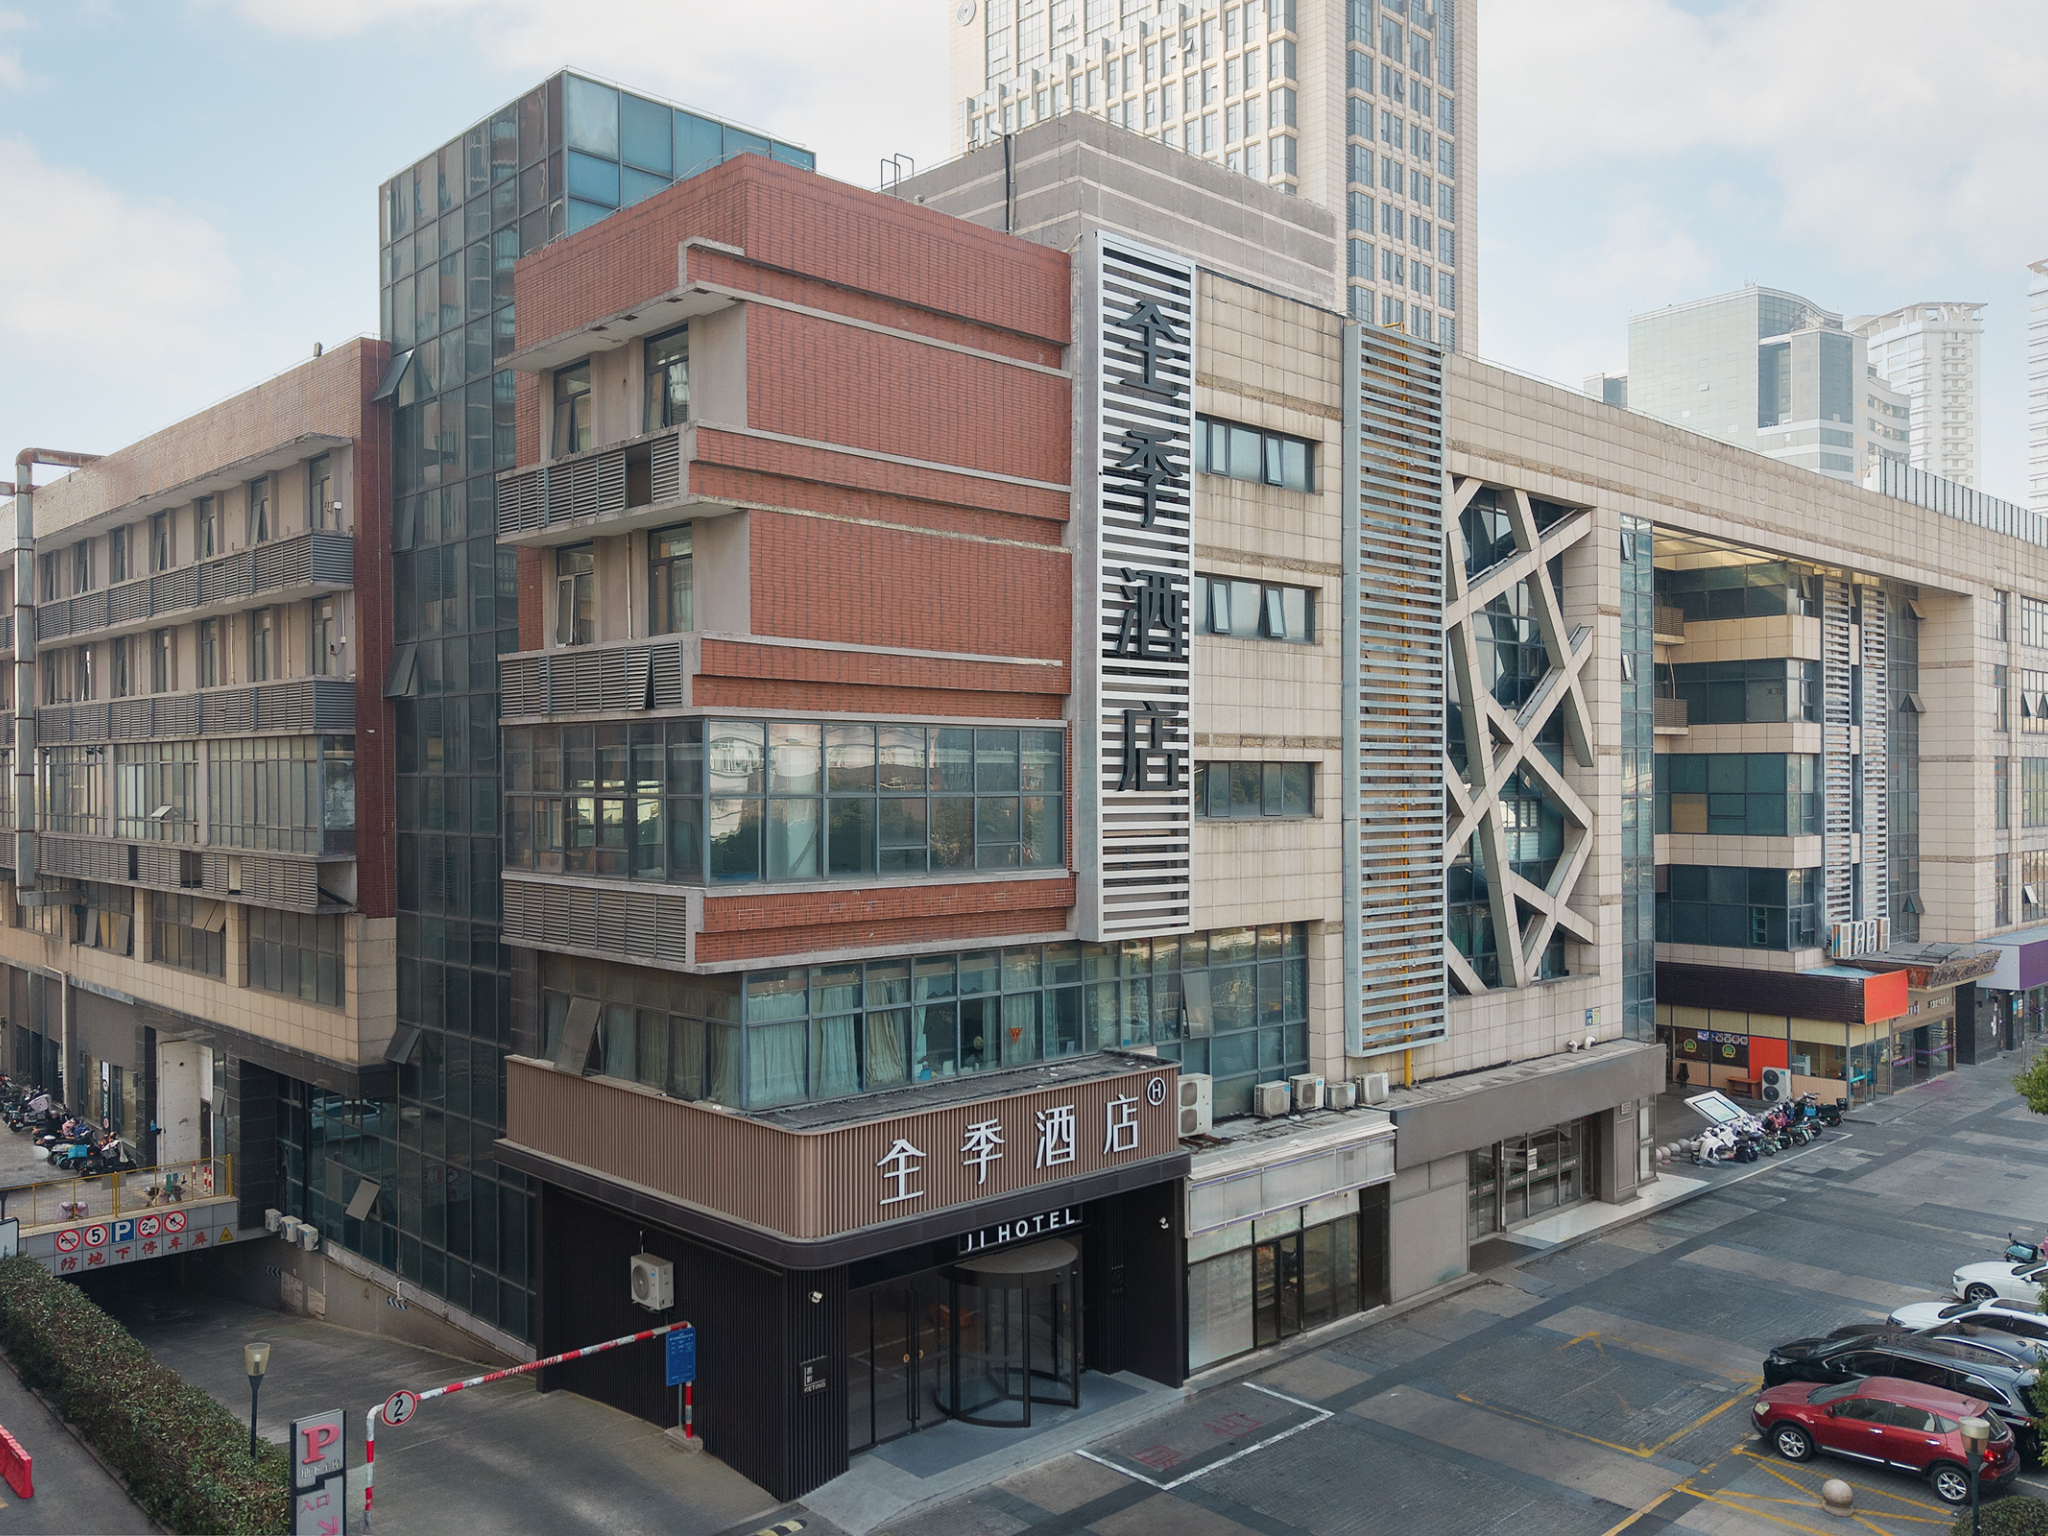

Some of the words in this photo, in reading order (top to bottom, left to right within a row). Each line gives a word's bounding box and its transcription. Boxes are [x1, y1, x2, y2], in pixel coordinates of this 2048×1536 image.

[1116, 300, 1183, 792] 全季酒店
[876, 1093, 1139, 1206] 全季酒店
[91, 1229, 101, 1243] 5
[115, 1221, 131, 1242] P
[142, 1222, 156, 1232] 2m
[967, 1230, 985, 1252] JI
[998, 1208, 1076, 1244] HOTEL
[40, 1232, 208, 1274] 防地下停车库
[301, 1423, 341, 1465] P
[300, 1494, 330, 1514] 入口
